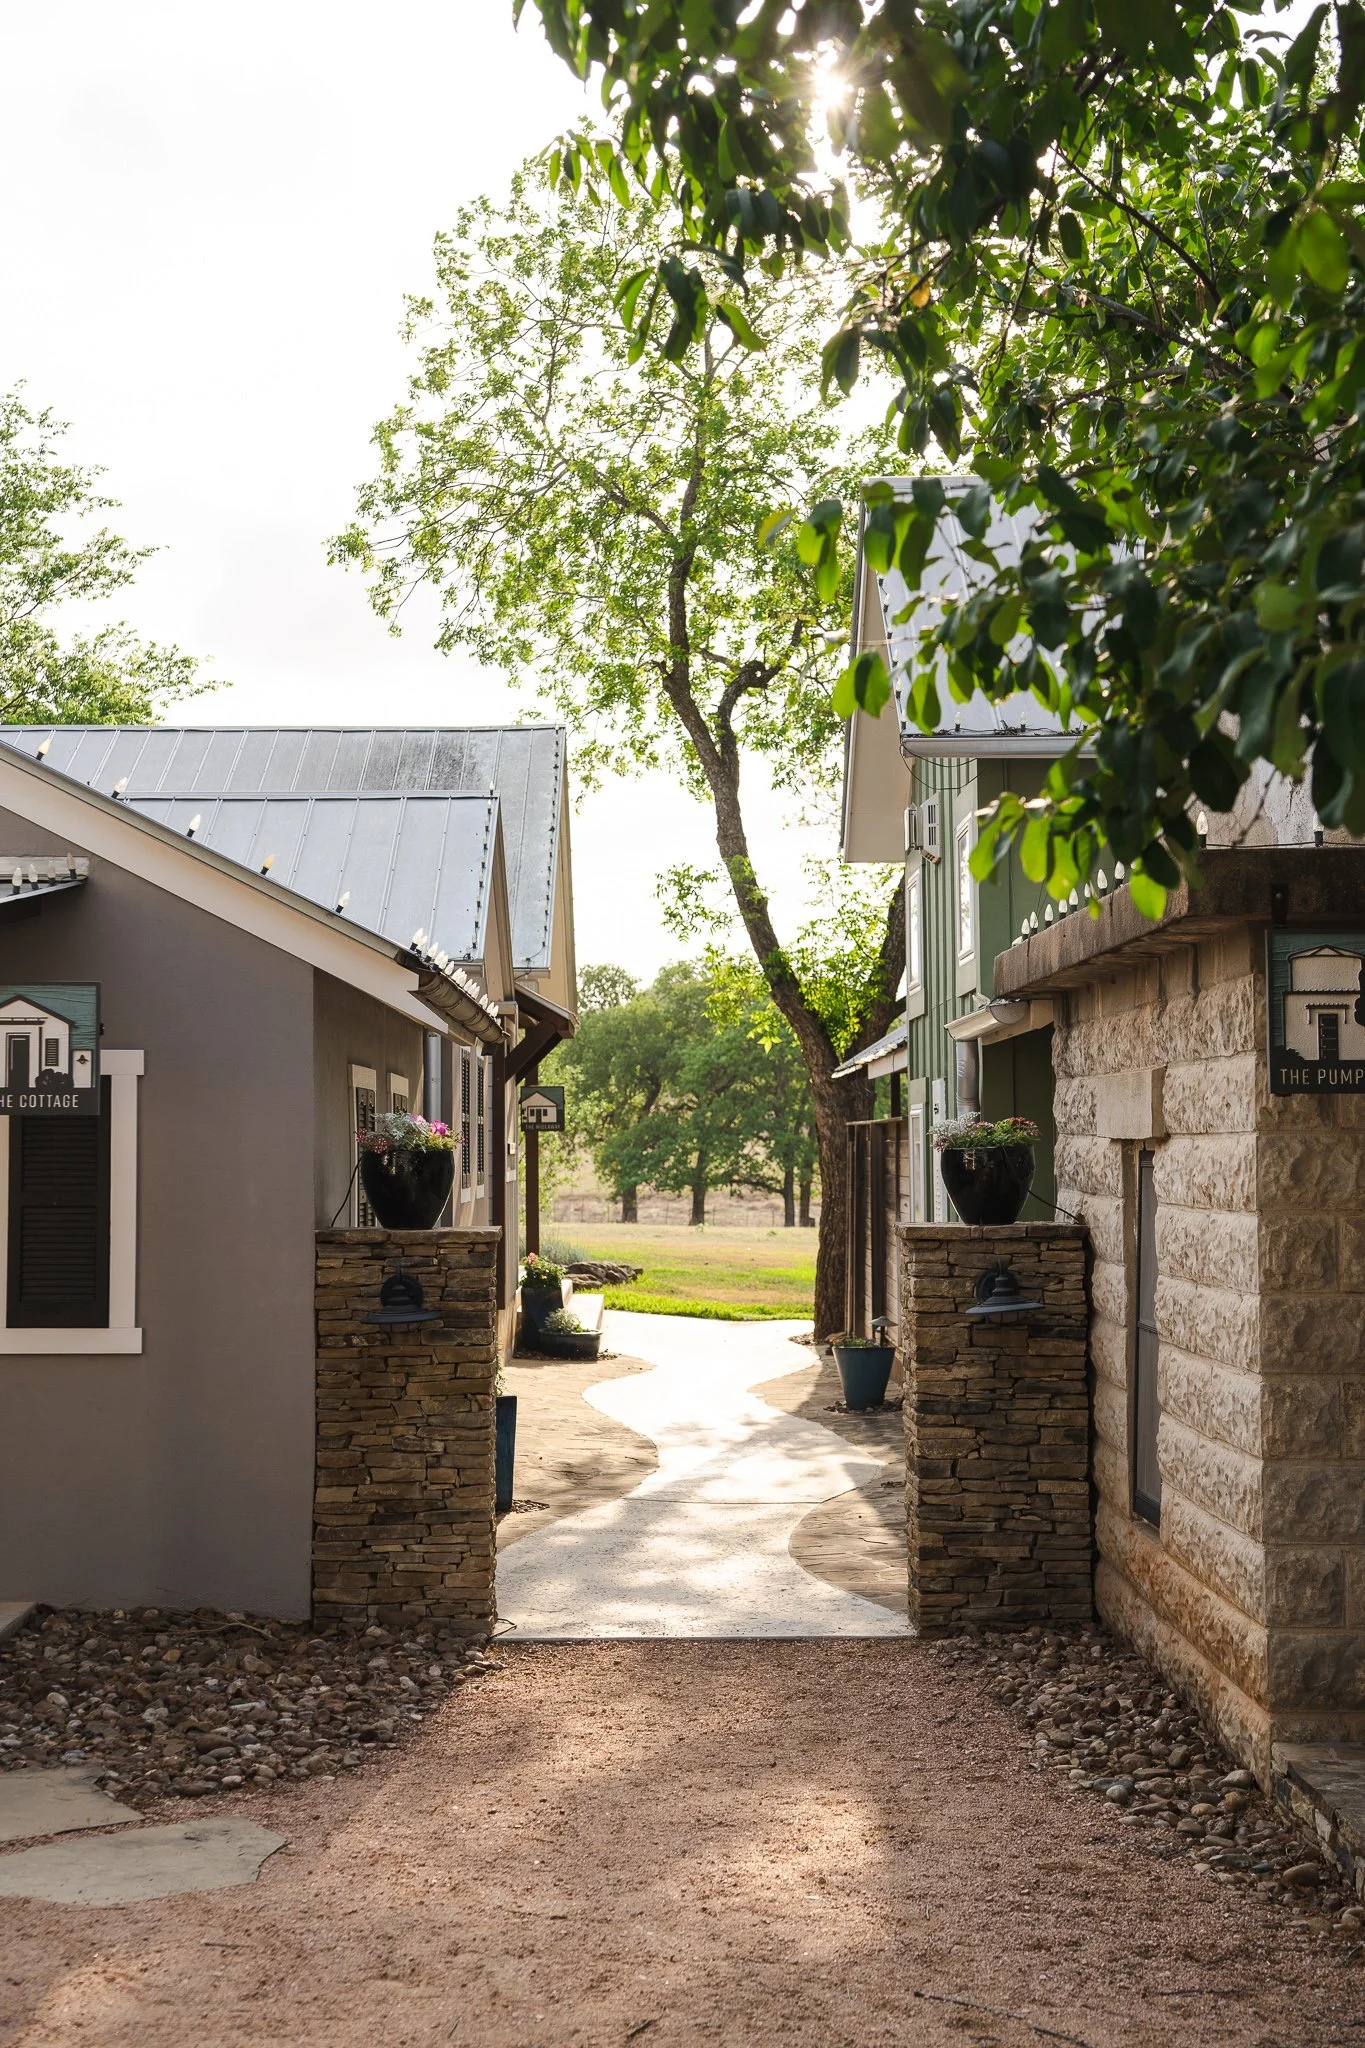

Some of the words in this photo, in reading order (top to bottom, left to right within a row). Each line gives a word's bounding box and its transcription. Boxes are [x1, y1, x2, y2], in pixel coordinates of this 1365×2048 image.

[1280, 1068, 1310, 1085] THE
[1318, 1068, 1364, 1085] PUMP
[19, 1094, 80, 1108] COTTAGE
